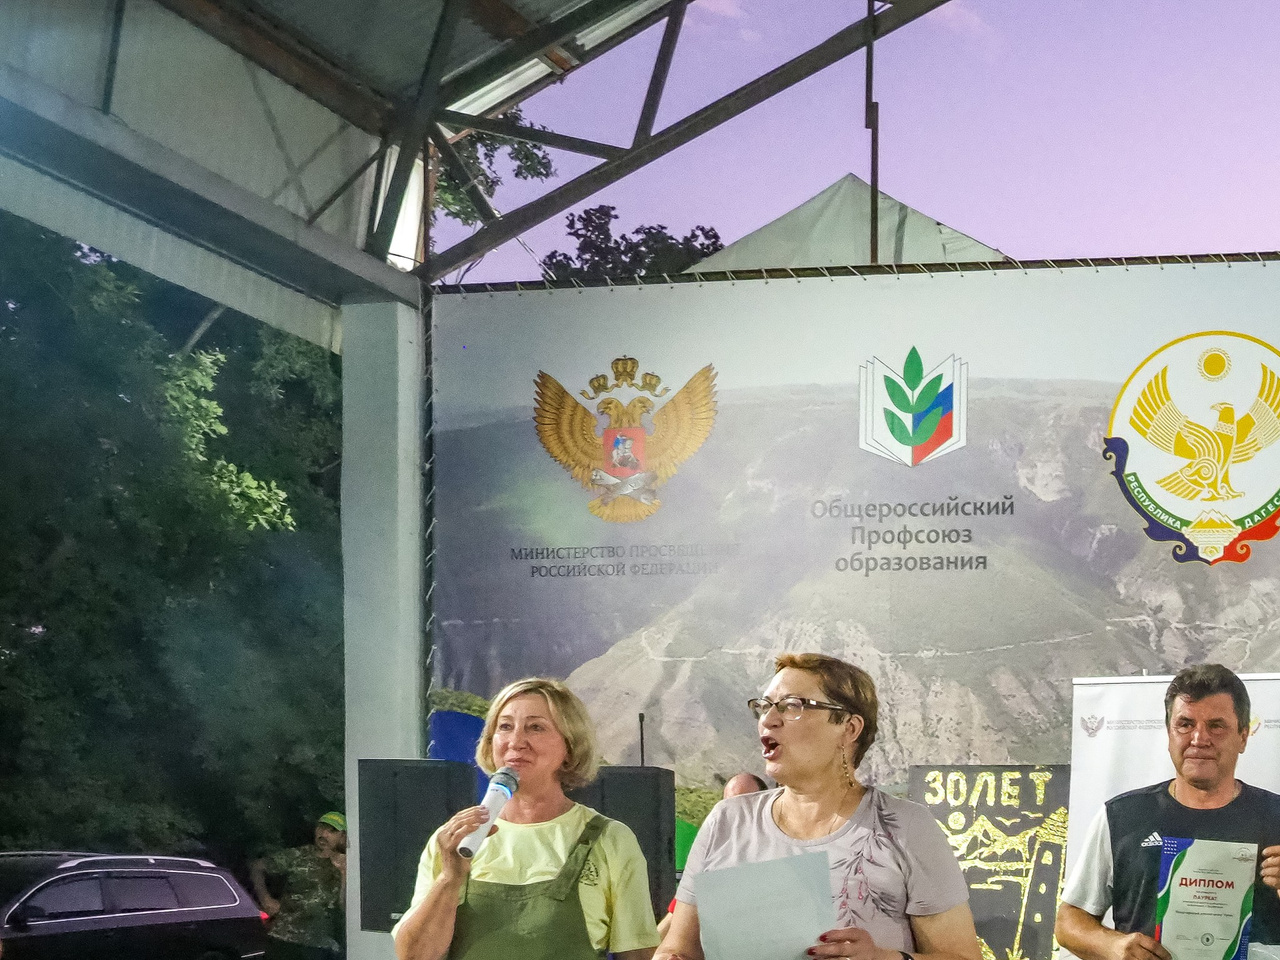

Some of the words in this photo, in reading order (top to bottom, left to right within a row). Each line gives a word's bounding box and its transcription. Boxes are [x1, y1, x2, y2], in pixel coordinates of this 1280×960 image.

[810, 494, 1016, 521] Общероссийский
[1127, 474, 1182, 530] РЕСПУБЛИКА
[851, 524, 973, 550] Профсоюз
[510, 546, 625, 561] МИНИСТЕРСТВО
[835, 551, 988, 576] образования
[530, 561, 626, 578] РОССИЙСКОЙ
[1179, 877, 1235, 890] ДИПЛОМ
